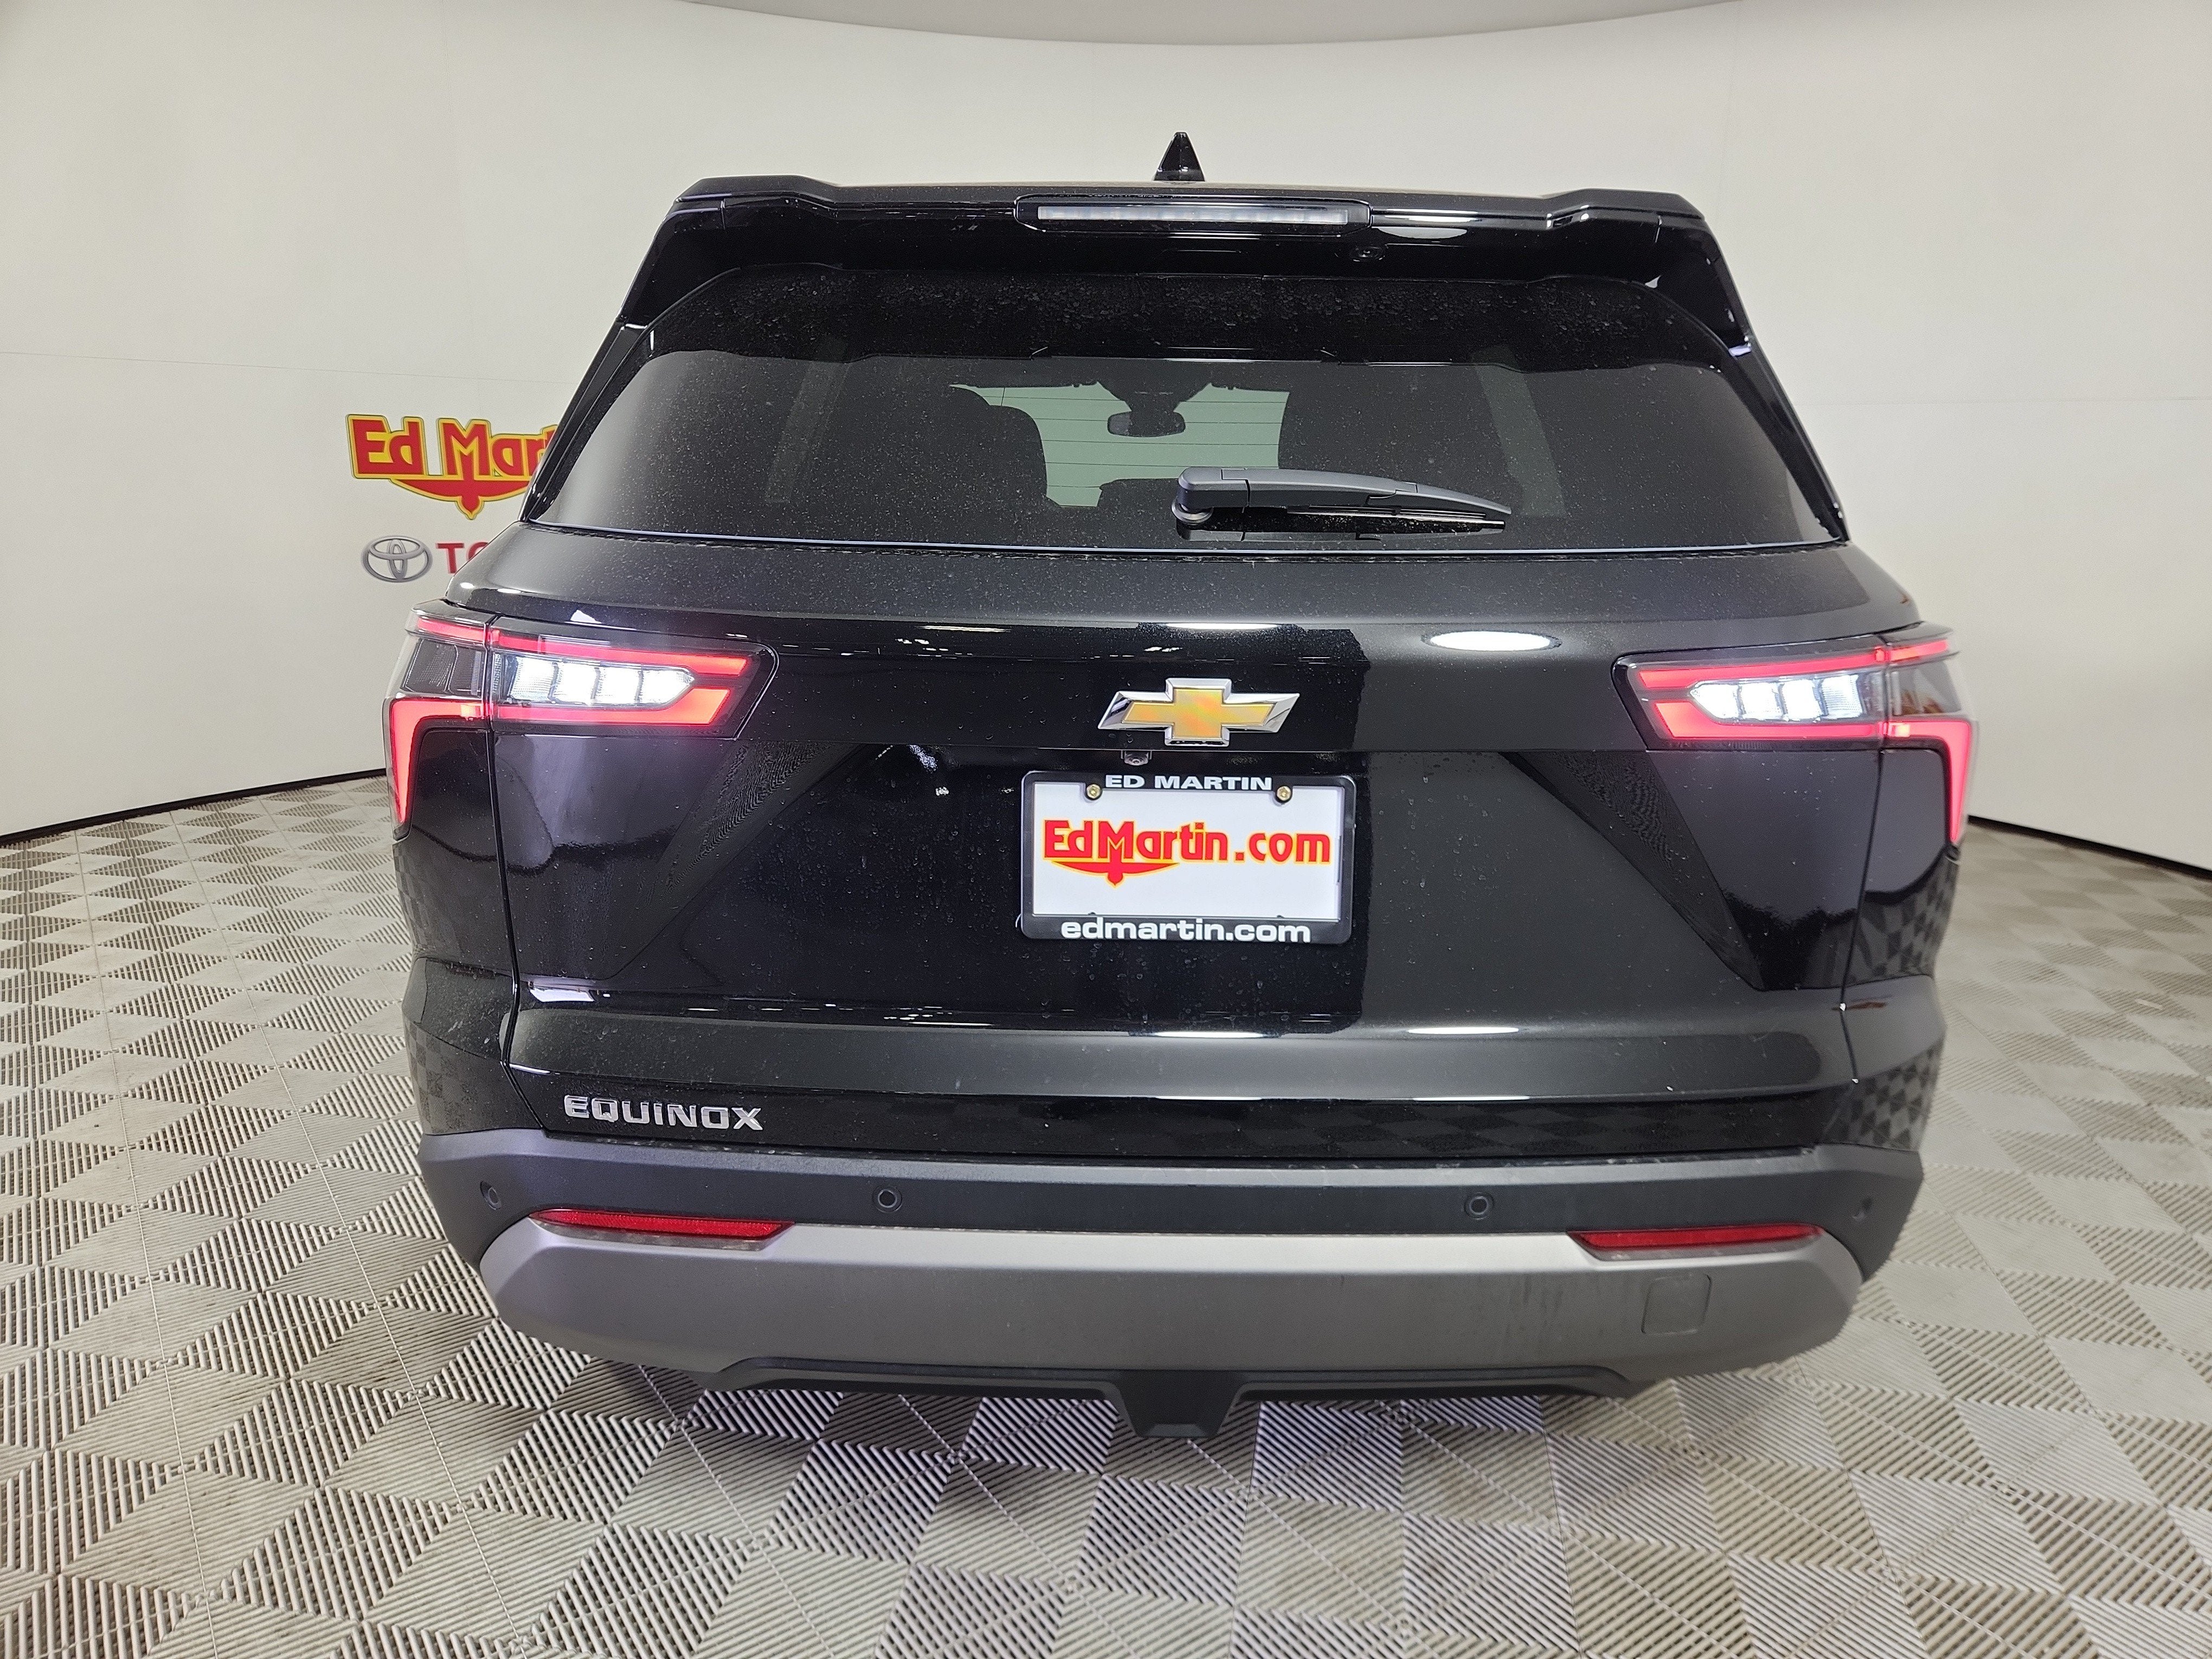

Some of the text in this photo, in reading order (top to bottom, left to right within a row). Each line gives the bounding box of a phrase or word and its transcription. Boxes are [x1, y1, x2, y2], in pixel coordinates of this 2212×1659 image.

[348, 415, 558, 519] Ed Mar
[1105, 775, 1272, 790] ED MARTIN
[1061, 917, 1311, 942] edmartin.com
[564, 1095, 763, 1130] EQUINOX
